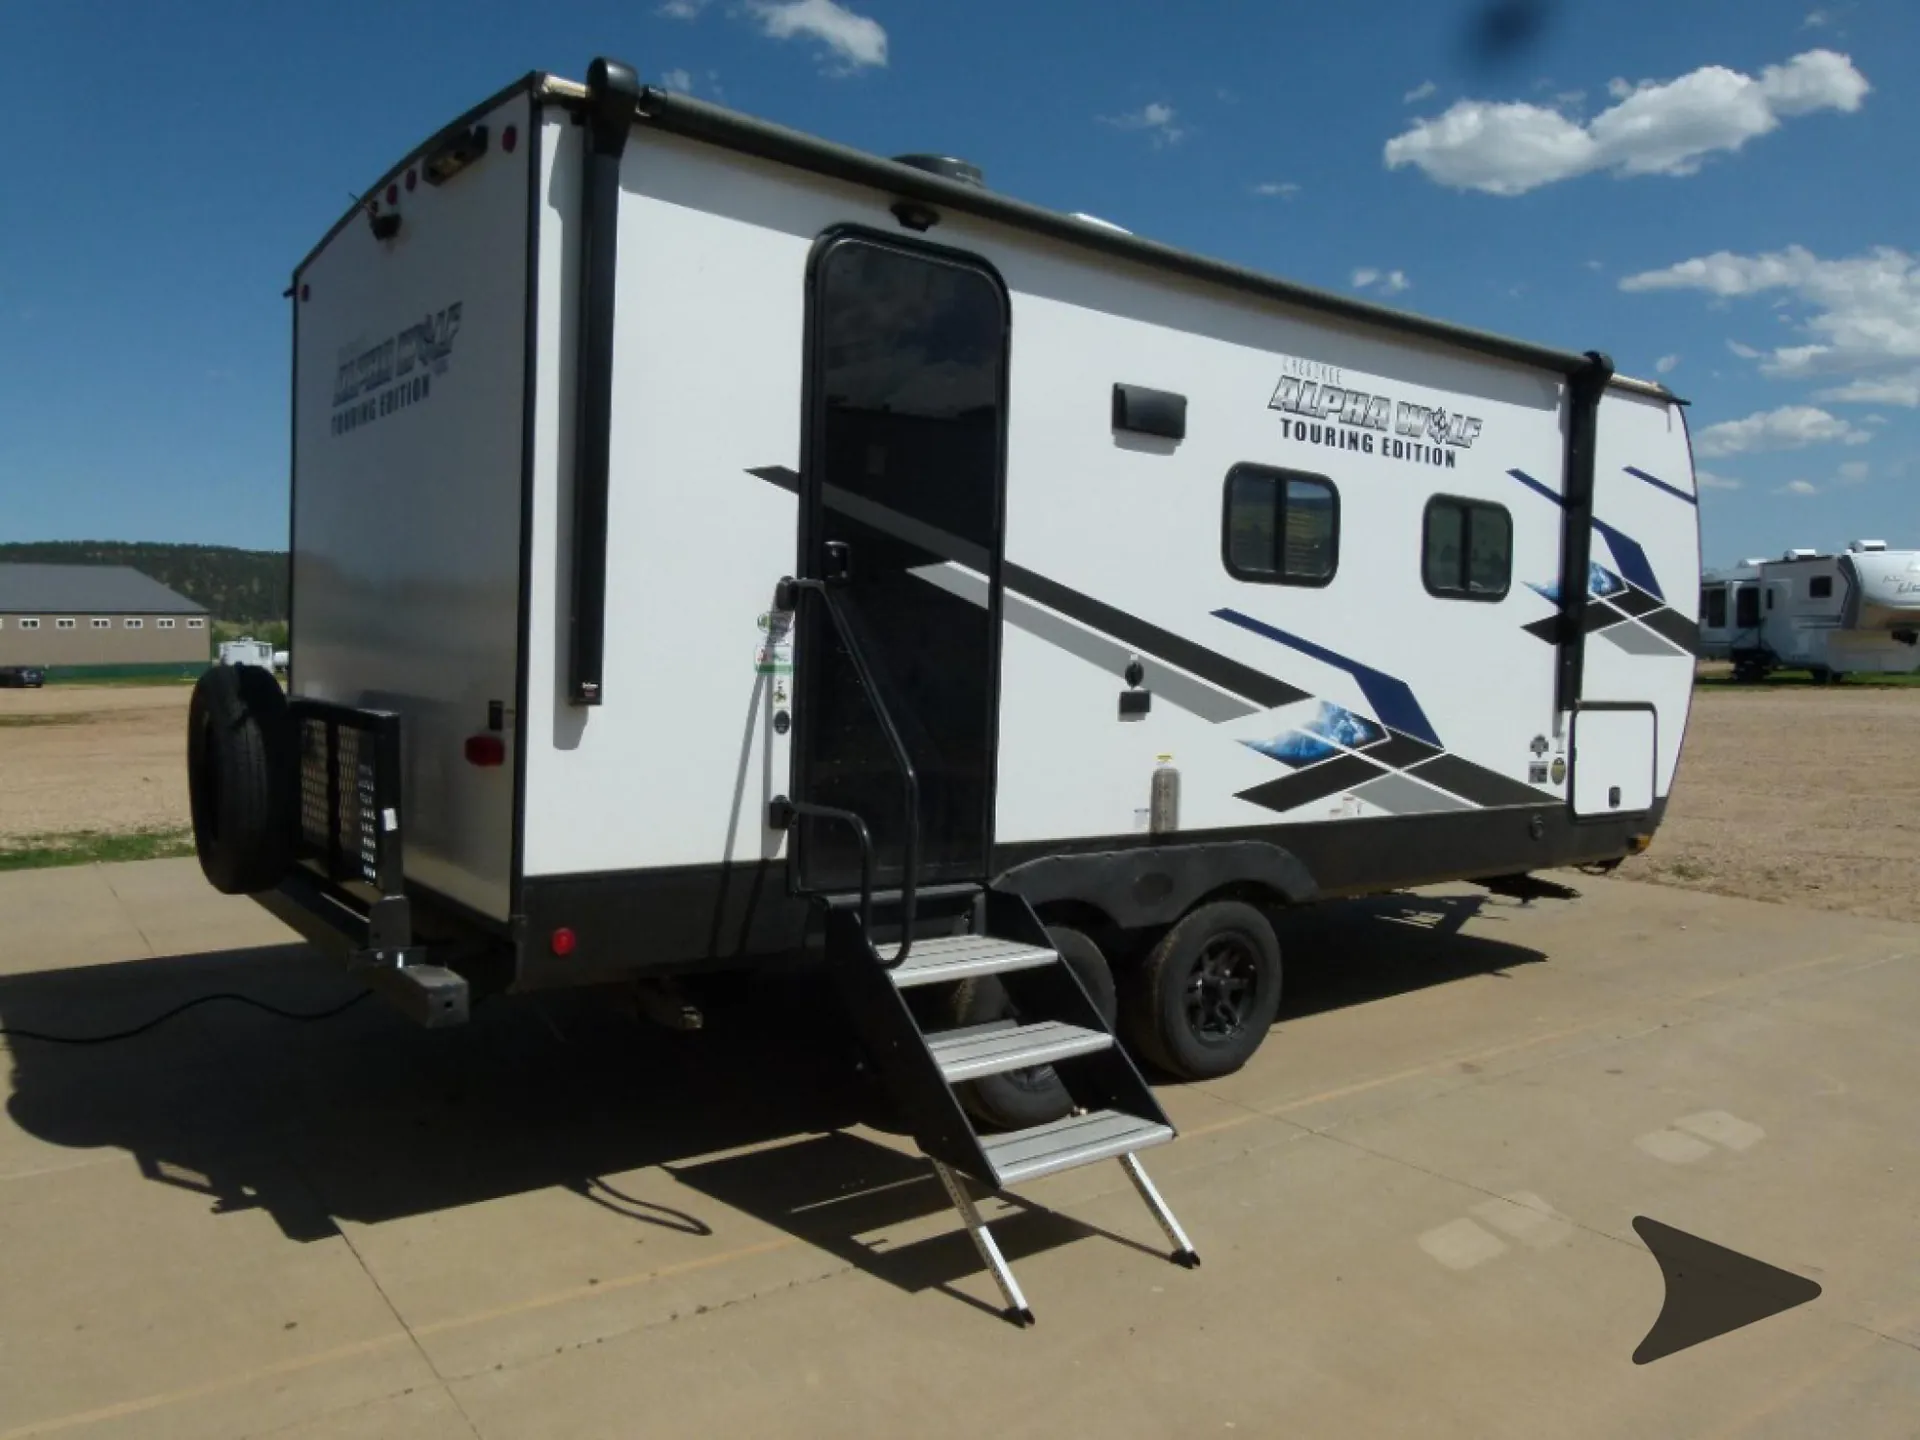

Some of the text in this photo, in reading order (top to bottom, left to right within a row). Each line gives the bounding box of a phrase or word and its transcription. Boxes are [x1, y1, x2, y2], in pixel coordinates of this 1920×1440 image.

[1267, 375, 1391, 431] ALPHA
[1280, 418, 1456, 469] TOURING EDITION
